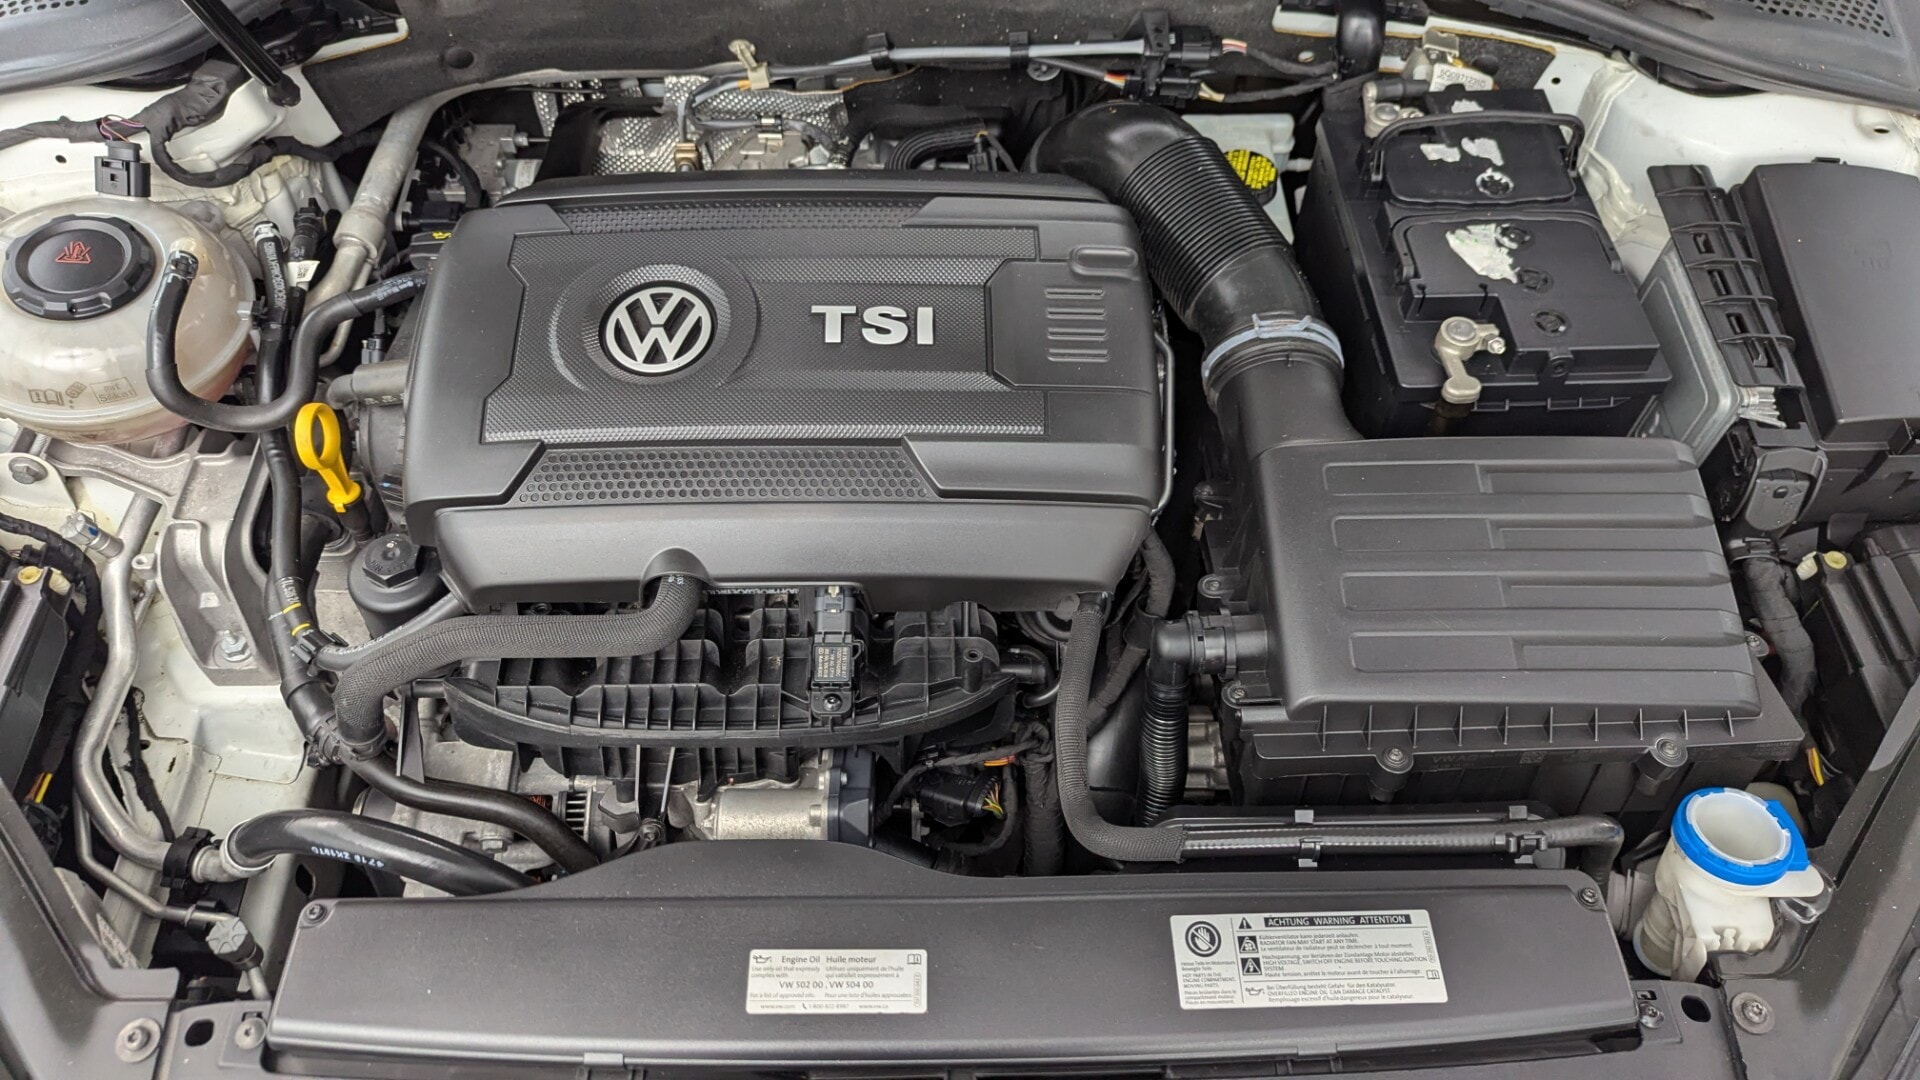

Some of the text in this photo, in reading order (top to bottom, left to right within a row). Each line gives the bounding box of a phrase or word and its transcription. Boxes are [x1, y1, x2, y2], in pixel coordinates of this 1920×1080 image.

[604, 285, 712, 374] VW
[811, 305, 934, 346] TSI
[1268, 915, 1406, 926] ACHTUNG WARNING ATTENTION
[781, 956, 807, 965] Engine
[809, 955, 820, 963] Oil
